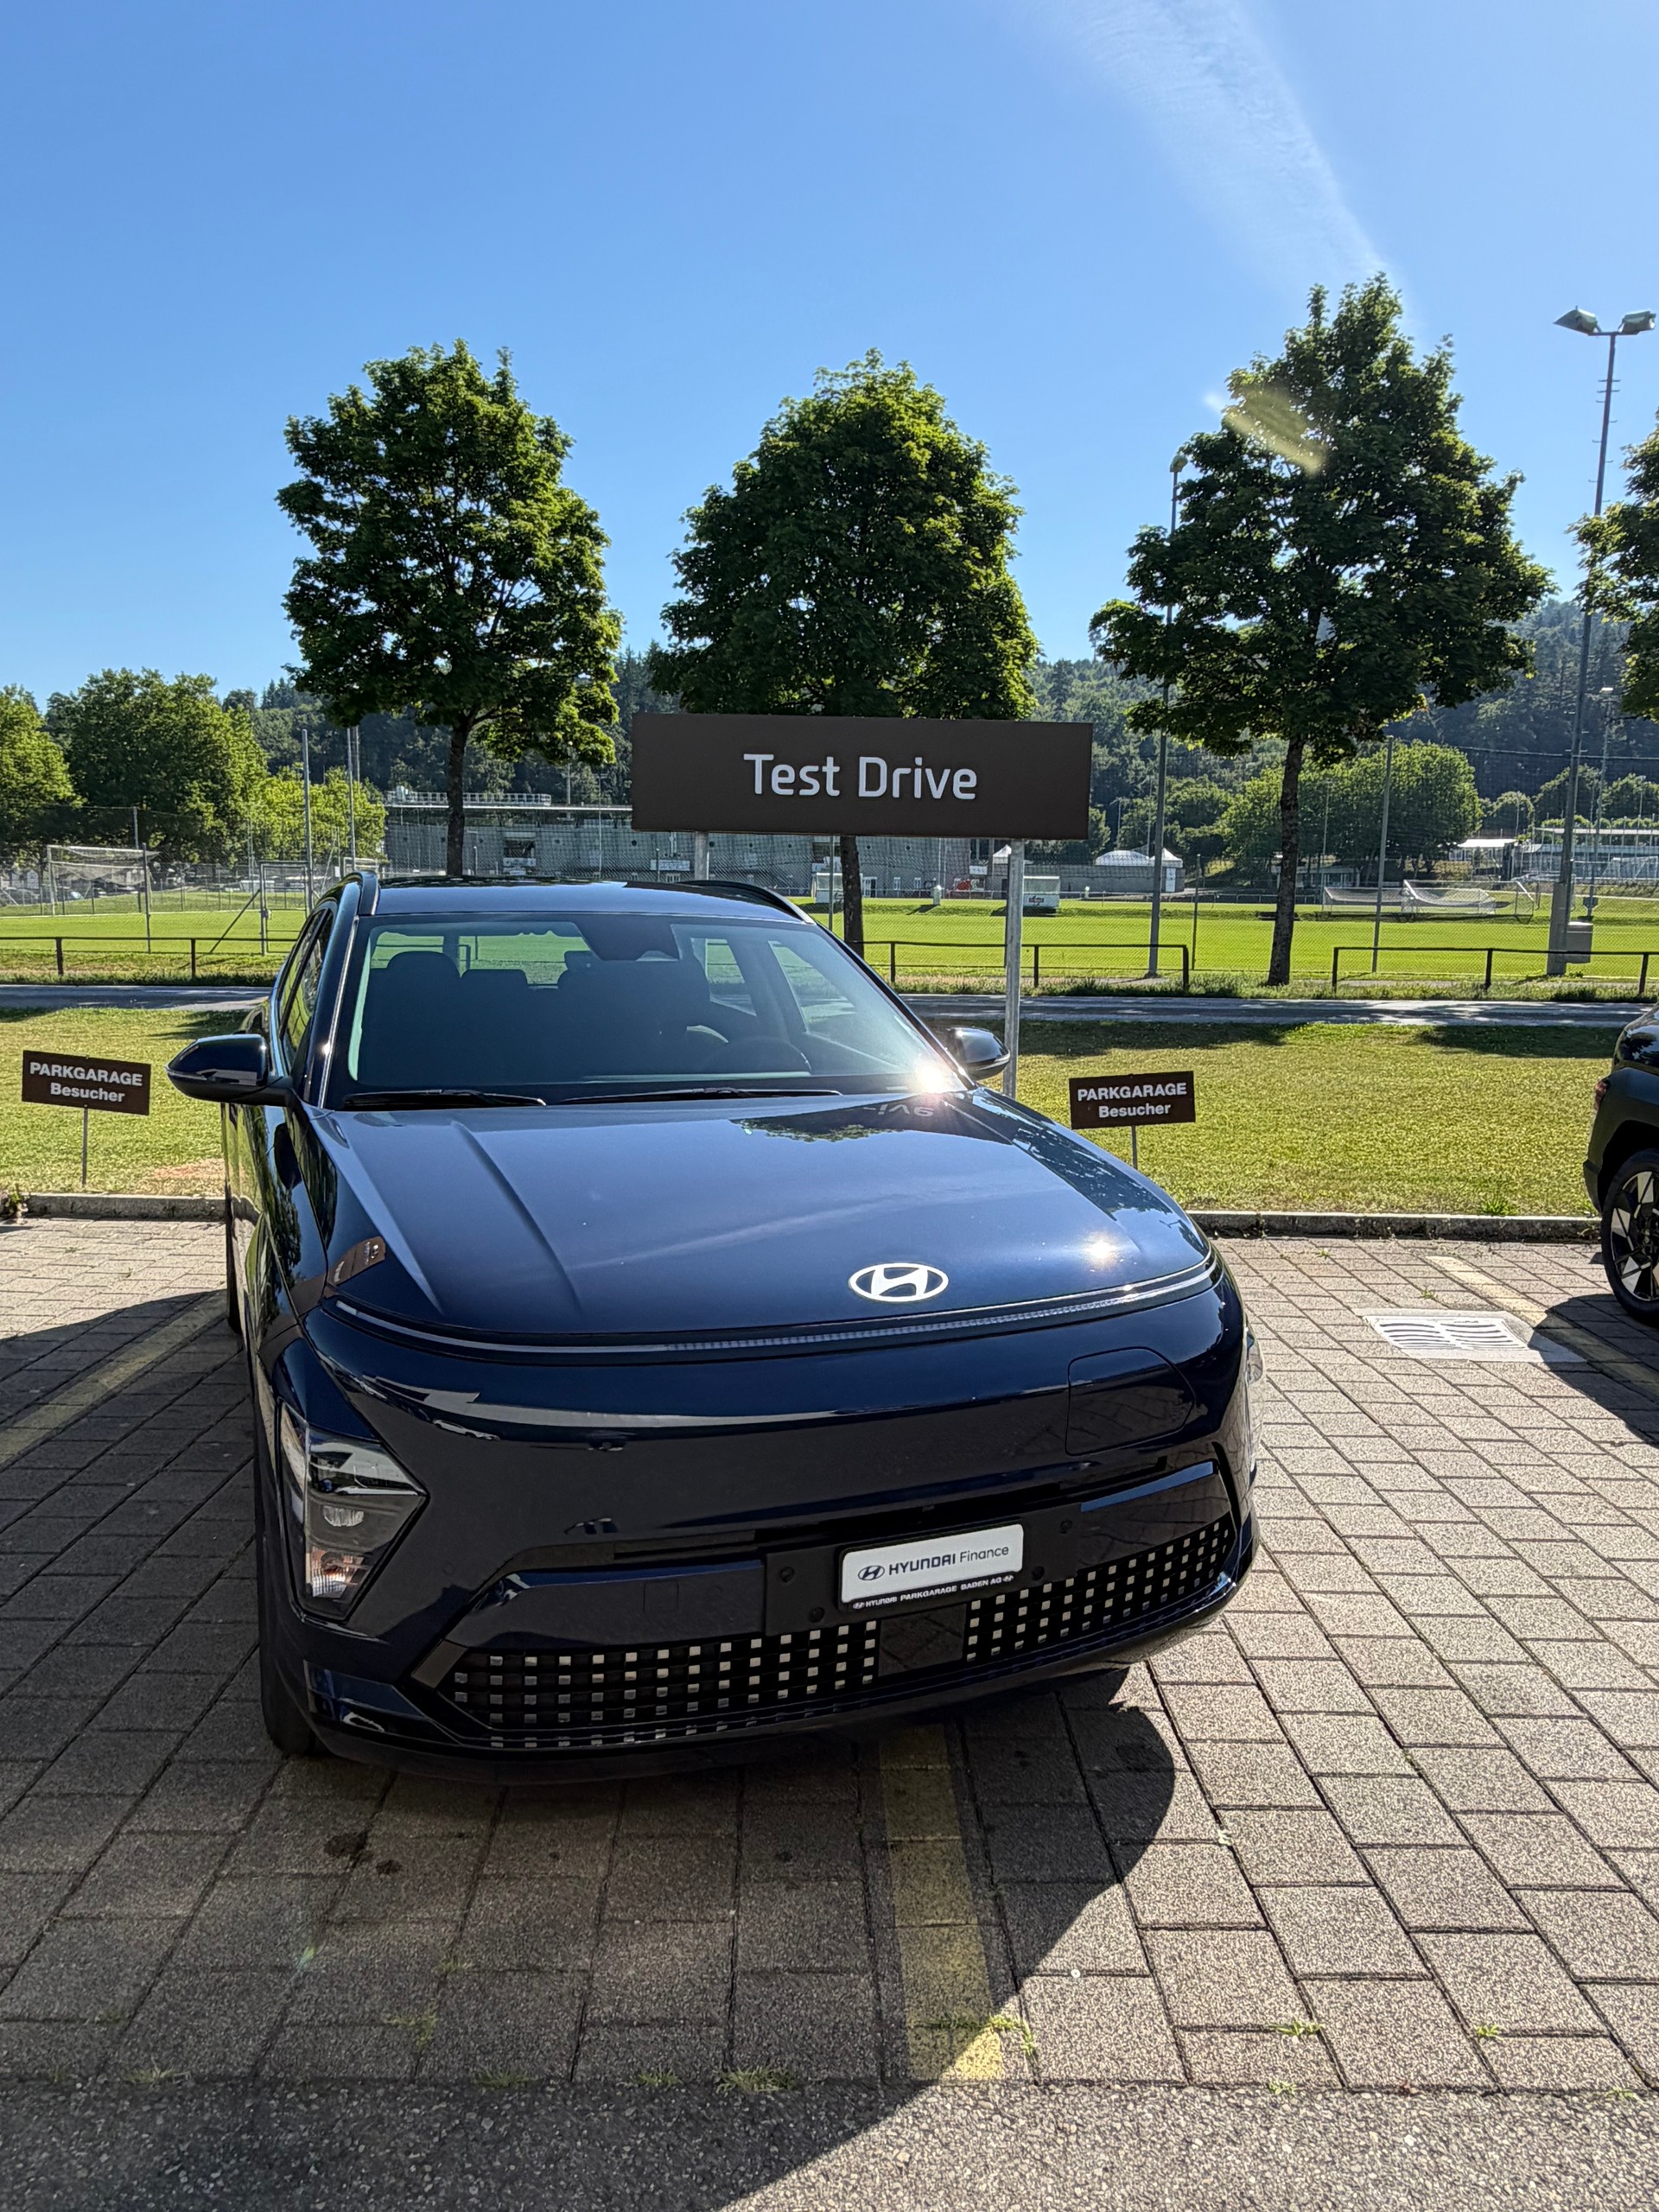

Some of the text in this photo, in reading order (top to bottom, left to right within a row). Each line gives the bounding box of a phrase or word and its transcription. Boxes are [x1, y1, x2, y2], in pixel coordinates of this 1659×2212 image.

[743, 753, 977, 800] Test Drive
[29, 1062, 143, 1086] PARKGARAGE
[50, 1082, 125, 1103] Besucher
[1077, 1082, 1187, 1102] PARKGARAGE
[1098, 1103, 1172, 1118] Besucher
[888, 1546, 1009, 1576] HYUNDAI Finance
[865, 1576, 1002, 1608] HYUNDAI PARKGARAGE BADEN AG
